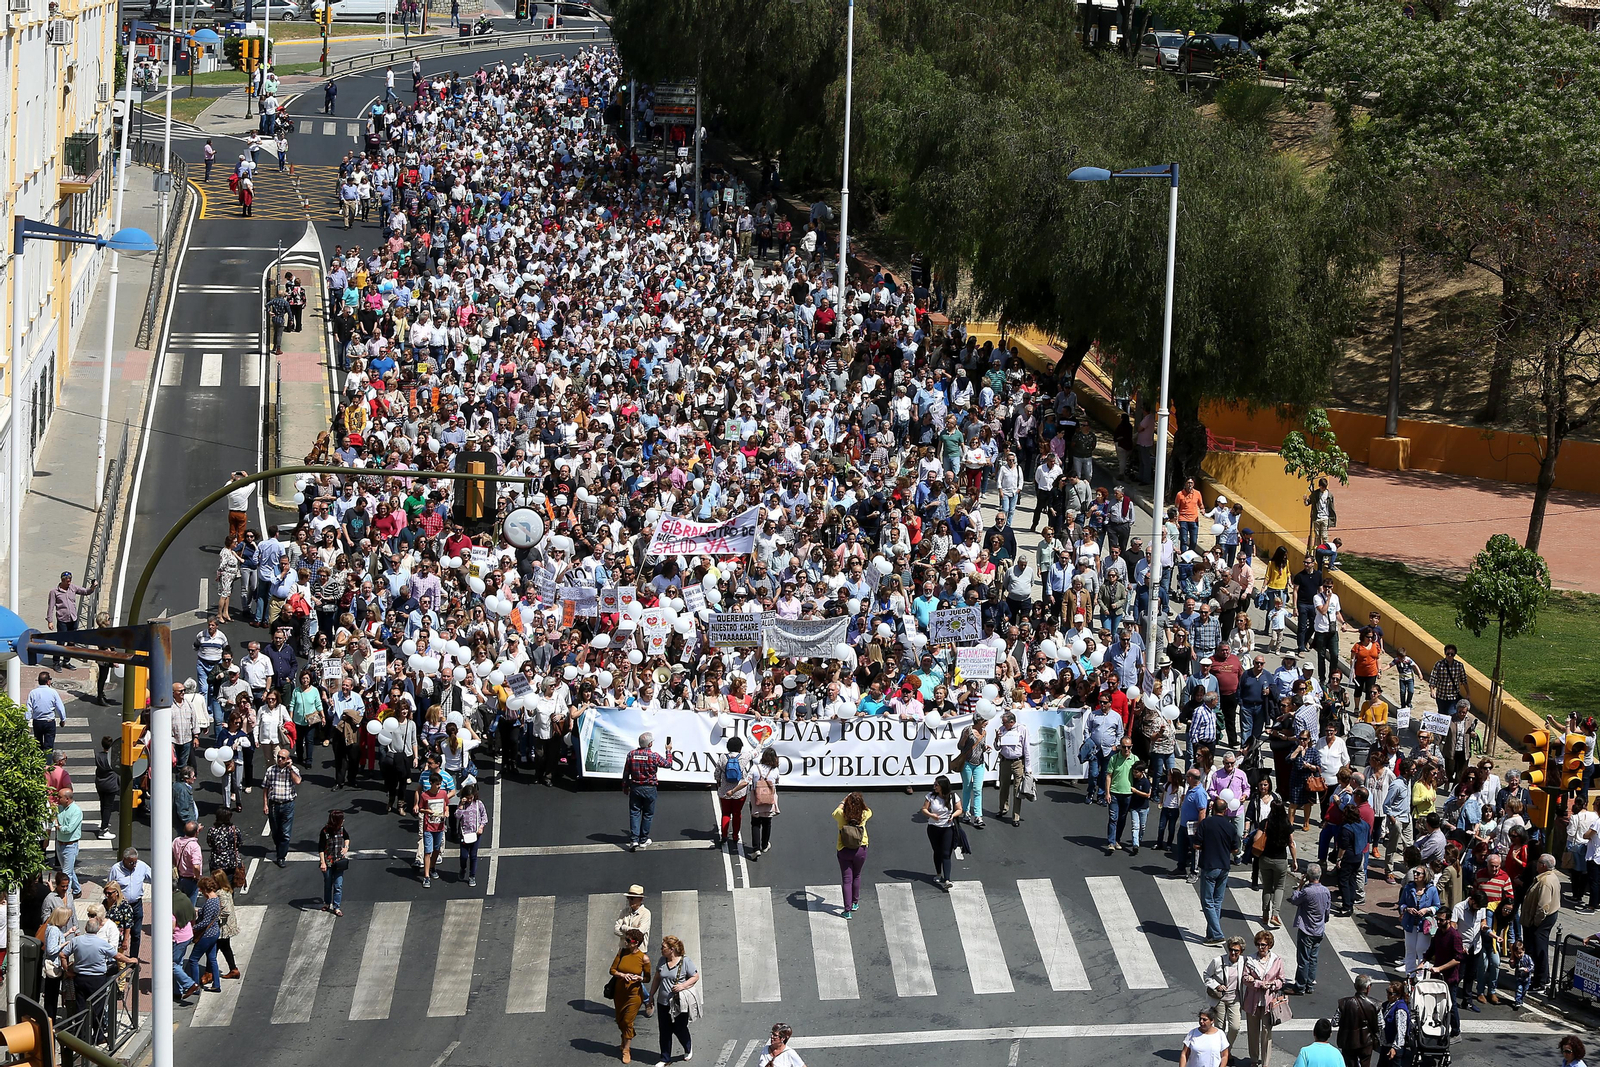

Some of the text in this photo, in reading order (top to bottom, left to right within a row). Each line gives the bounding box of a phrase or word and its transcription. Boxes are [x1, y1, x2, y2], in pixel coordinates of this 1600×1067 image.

[661, 517, 737, 537] GIBRALEN
[741, 525, 756, 537] DE
[652, 538, 698, 554] SALUD
[949, 608, 971, 616] JUEGO
[716, 614, 754, 623] QUEREMOS
[711, 623, 759, 632] NUESTRO CHARE
[934, 635, 962, 643] NUESTRA
[840, 720, 895, 741] POR
[901, 720, 957, 741] UNA
[672, 750, 1001, 776] SAND PÚBLICA DINA
[1583, 979, 1597, 990] 959
